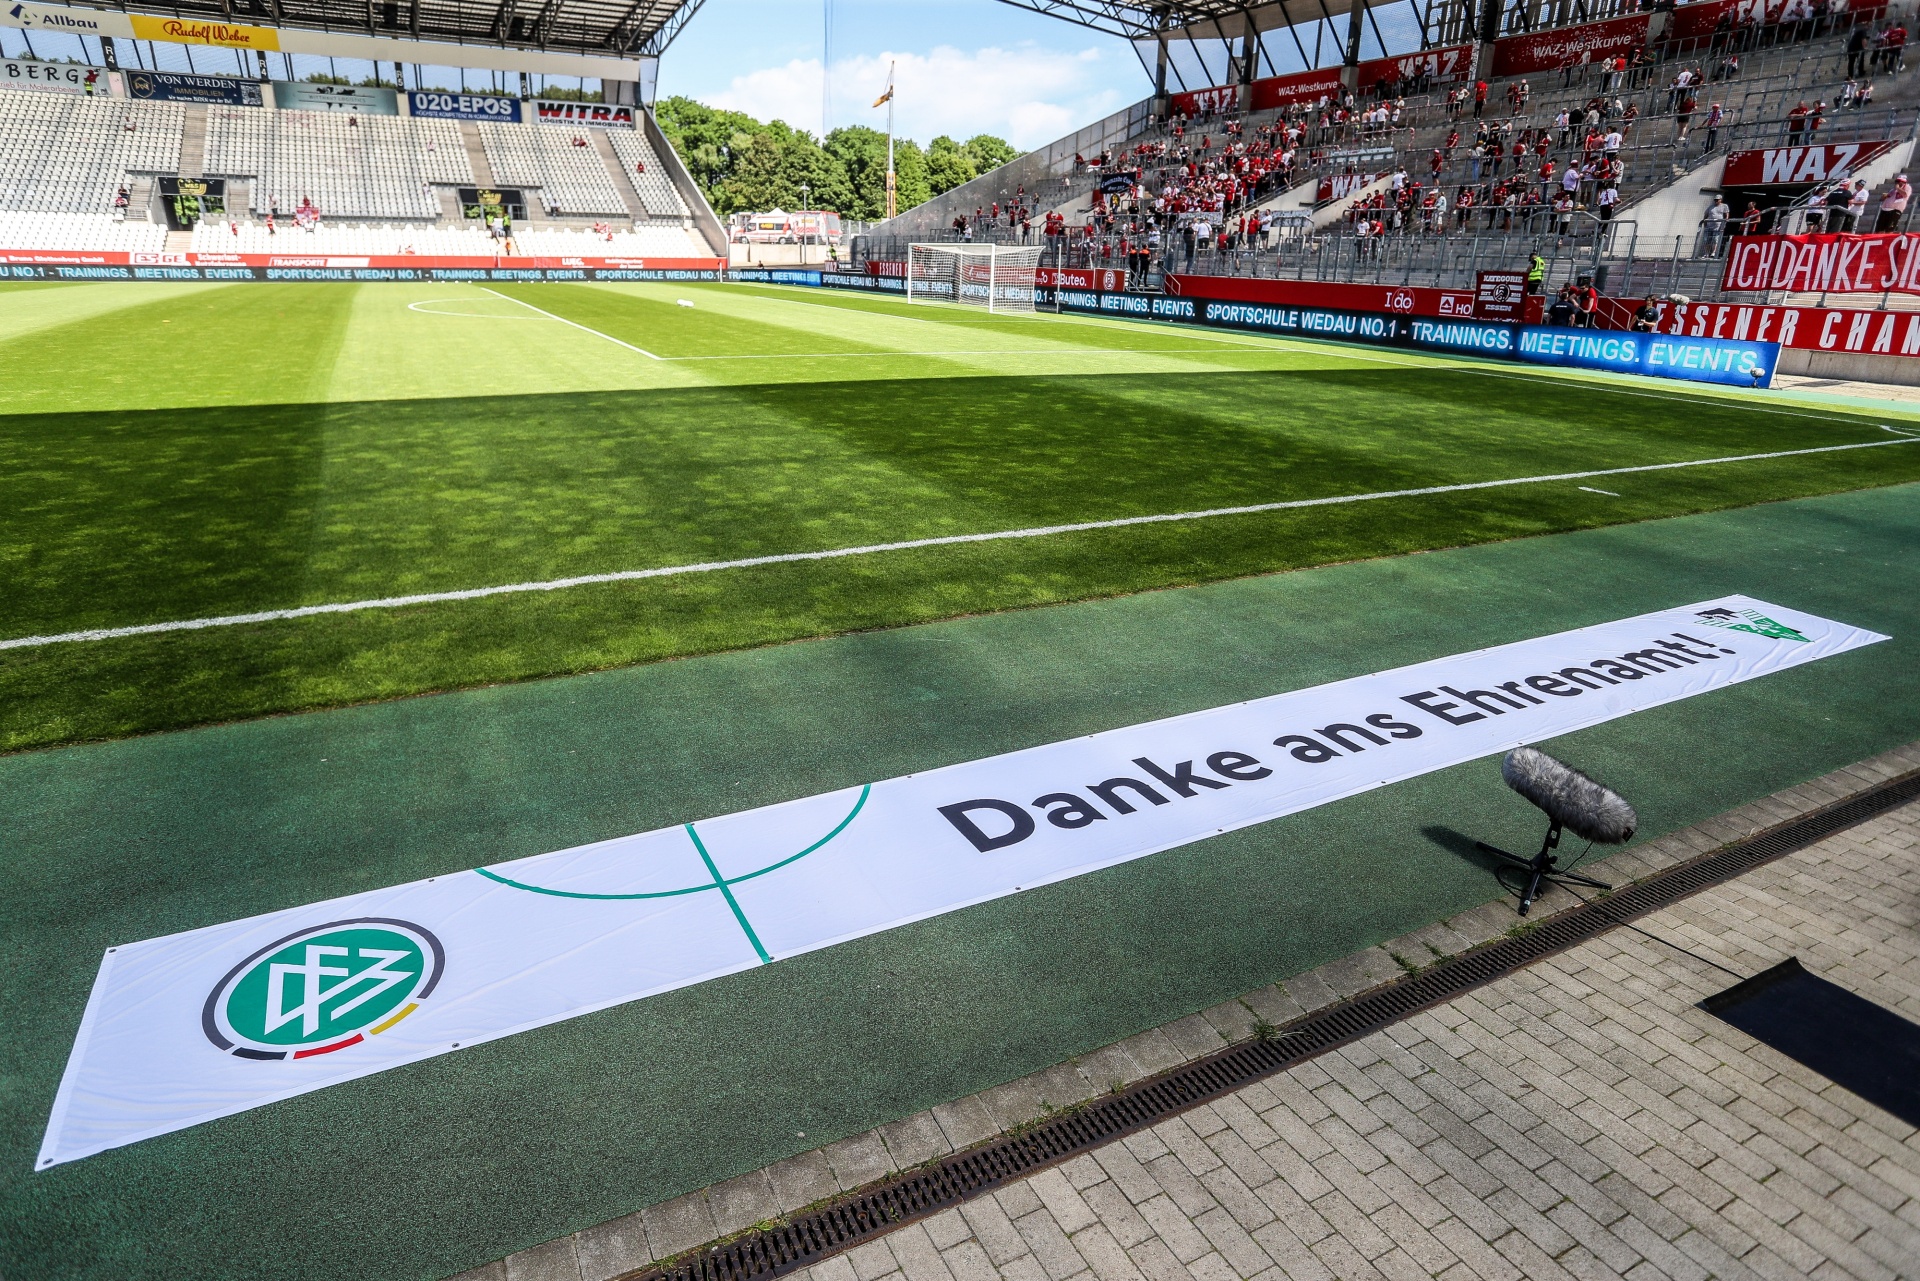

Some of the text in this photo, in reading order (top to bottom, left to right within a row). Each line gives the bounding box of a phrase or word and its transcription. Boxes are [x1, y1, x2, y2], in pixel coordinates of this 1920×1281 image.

[43, 15, 98, 29] Allbau
[163, 20, 250, 44] Rudolf Weber
[1533, 34, 1632, 59] WAZ-Westkurve
[5, 63, 79, 84] BERG
[154, 74, 237, 89] VON WERDEN
[29, 84, 80, 93] Malerarbeiten
[174, 87, 225, 97] IMMOBILIEN
[1278, 81, 1338, 97] WAZ-Westkurve
[415, 94, 512, 115] 020-EPOS
[537, 102, 632, 122] WITRA
[585, 121, 633, 129] IMMOBILIEN
[1762, 144, 1859, 183] WAZ
[13, 267, 45, 278] NO.1
[56, 267, 132, 278] TRAININGS.
[135, 268, 203, 279] MEETINGS.
[205, 269, 256, 279] EVENTS.
[267, 269, 352, 279] SPORTSCHULE
[354, 270, 395, 279] WEDAU
[398, 270, 422, 279] NO.1
[431, 270, 489, 280] TRAININGS.
[491, 270, 544, 280] MEETINGS.
[547, 270, 587, 280] EVENTS.
[595, 270, 663, 280] SPORTSCHULE
[666, 271, 698, 280] WEDAU
[701, 271, 720, 280] NO.1
[728, 271, 771, 280] TRAININGS.
[1060, 274, 1087, 287] Buteo.
[1483, 274, 1523, 284] KATEGORIE
[1393, 293, 1413, 309] do
[1485, 304, 1512, 312] ESSEN
[1054, 292, 1099, 307] TRAININGS.
[1101, 295, 1150, 312] MEETINGS.
[1152, 300, 1196, 317] EVENTS.
[1207, 304, 1298, 328] SPORTSCHULE
[1301, 311, 1357, 334] WEDAU
[1360, 317, 1396, 338] NO.1
[1411, 322, 1514, 350] TRAININGS.
[1520, 332, 1640, 363] MEETINGS.
[1650, 303, 1800, 346] ESSENER
[938, 632, 1736, 852] Danke ans Ehrenamt!
